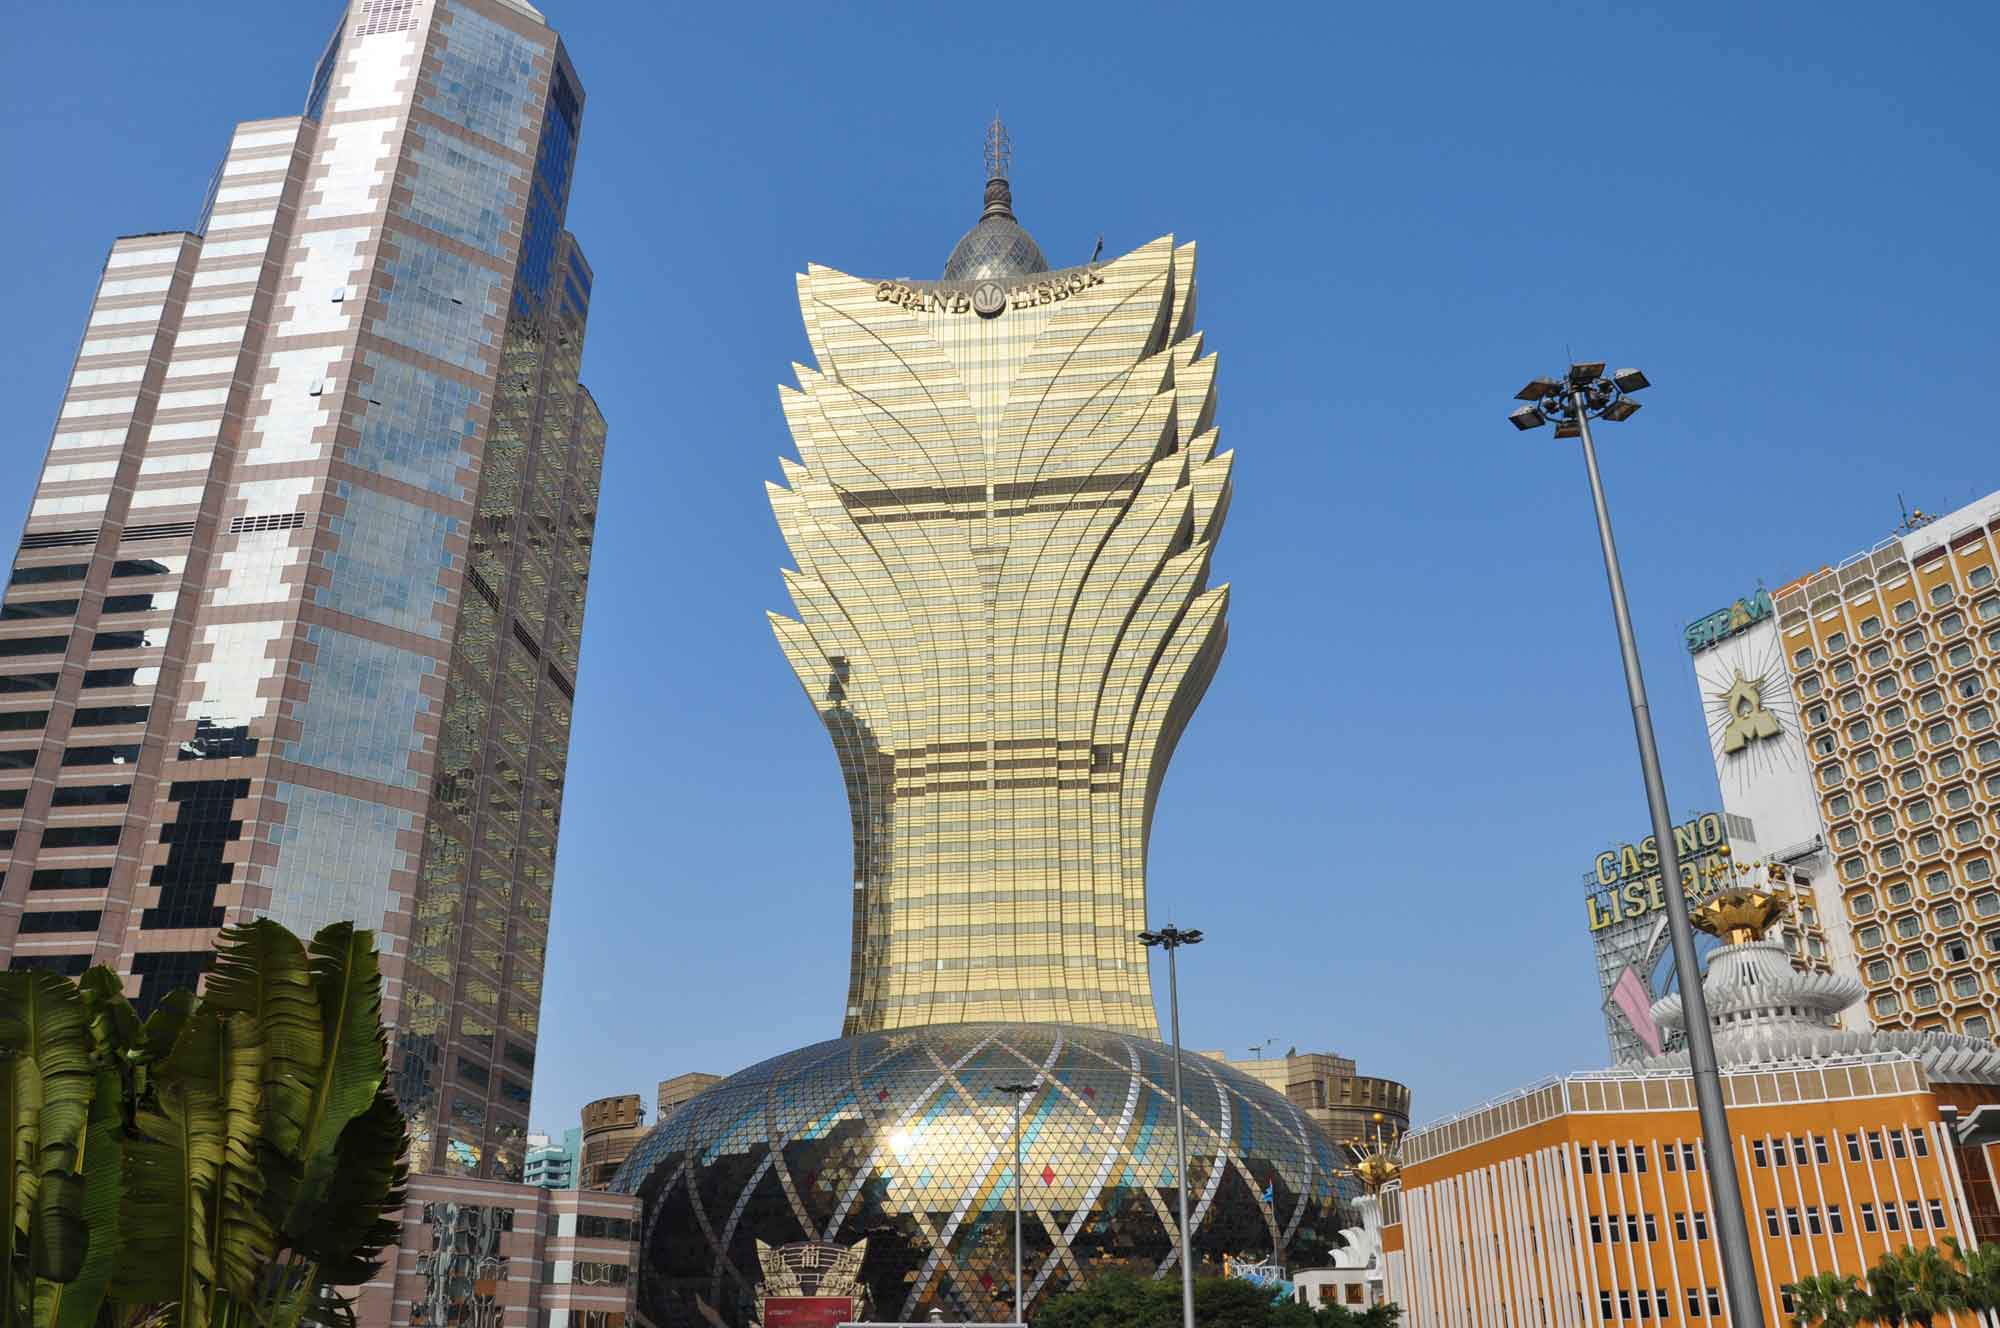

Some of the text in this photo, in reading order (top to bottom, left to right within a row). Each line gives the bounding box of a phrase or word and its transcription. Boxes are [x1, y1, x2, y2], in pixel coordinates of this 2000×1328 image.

[875, 267, 1105, 314] GRAND LISBOA
[1595, 812, 1722, 886] CASNO
